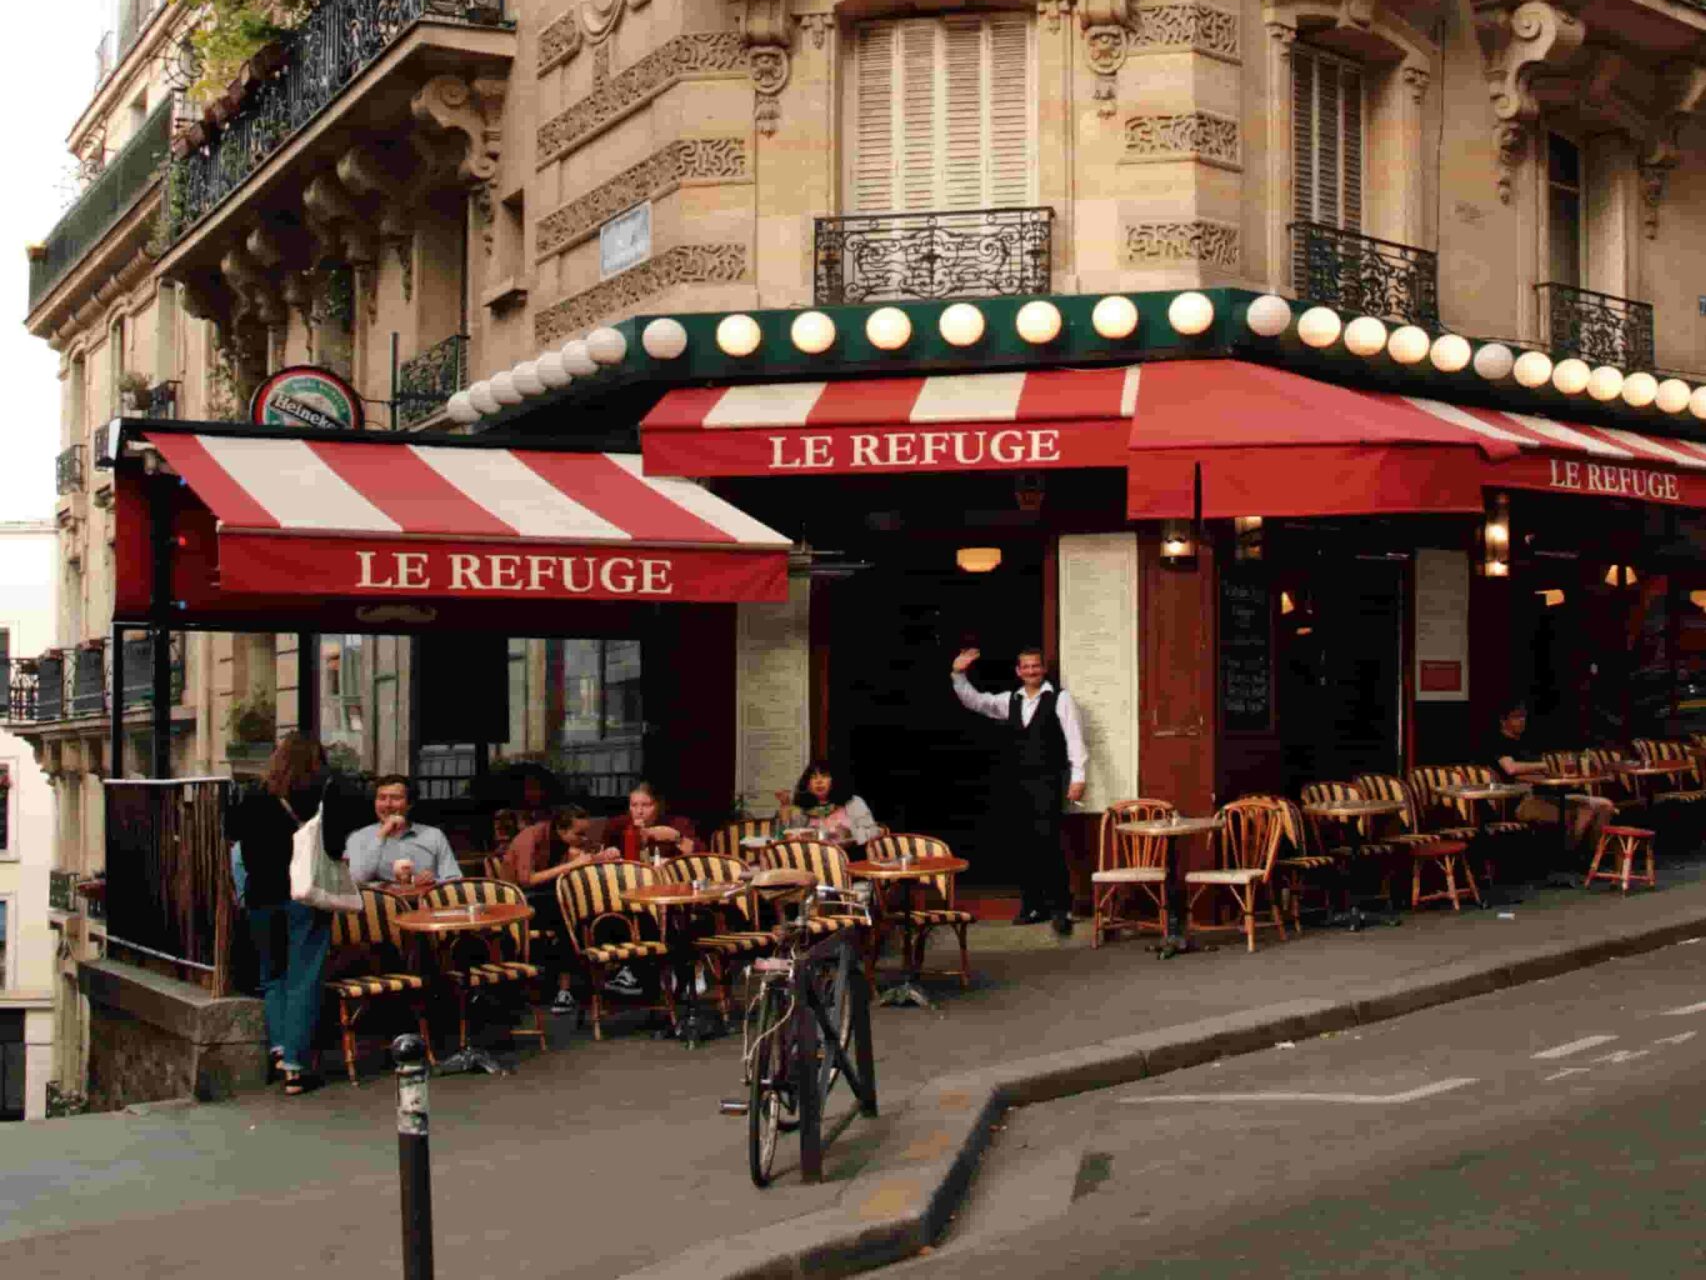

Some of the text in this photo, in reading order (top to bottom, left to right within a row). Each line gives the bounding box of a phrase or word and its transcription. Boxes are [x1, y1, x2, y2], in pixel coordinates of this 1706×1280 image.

[274, 393, 336, 429] Heineke
[769, 429, 1061, 468] LE REFUGE
[1550, 460, 1679, 500] LE REFUGE
[356, 551, 672, 594] LE REFUGE
